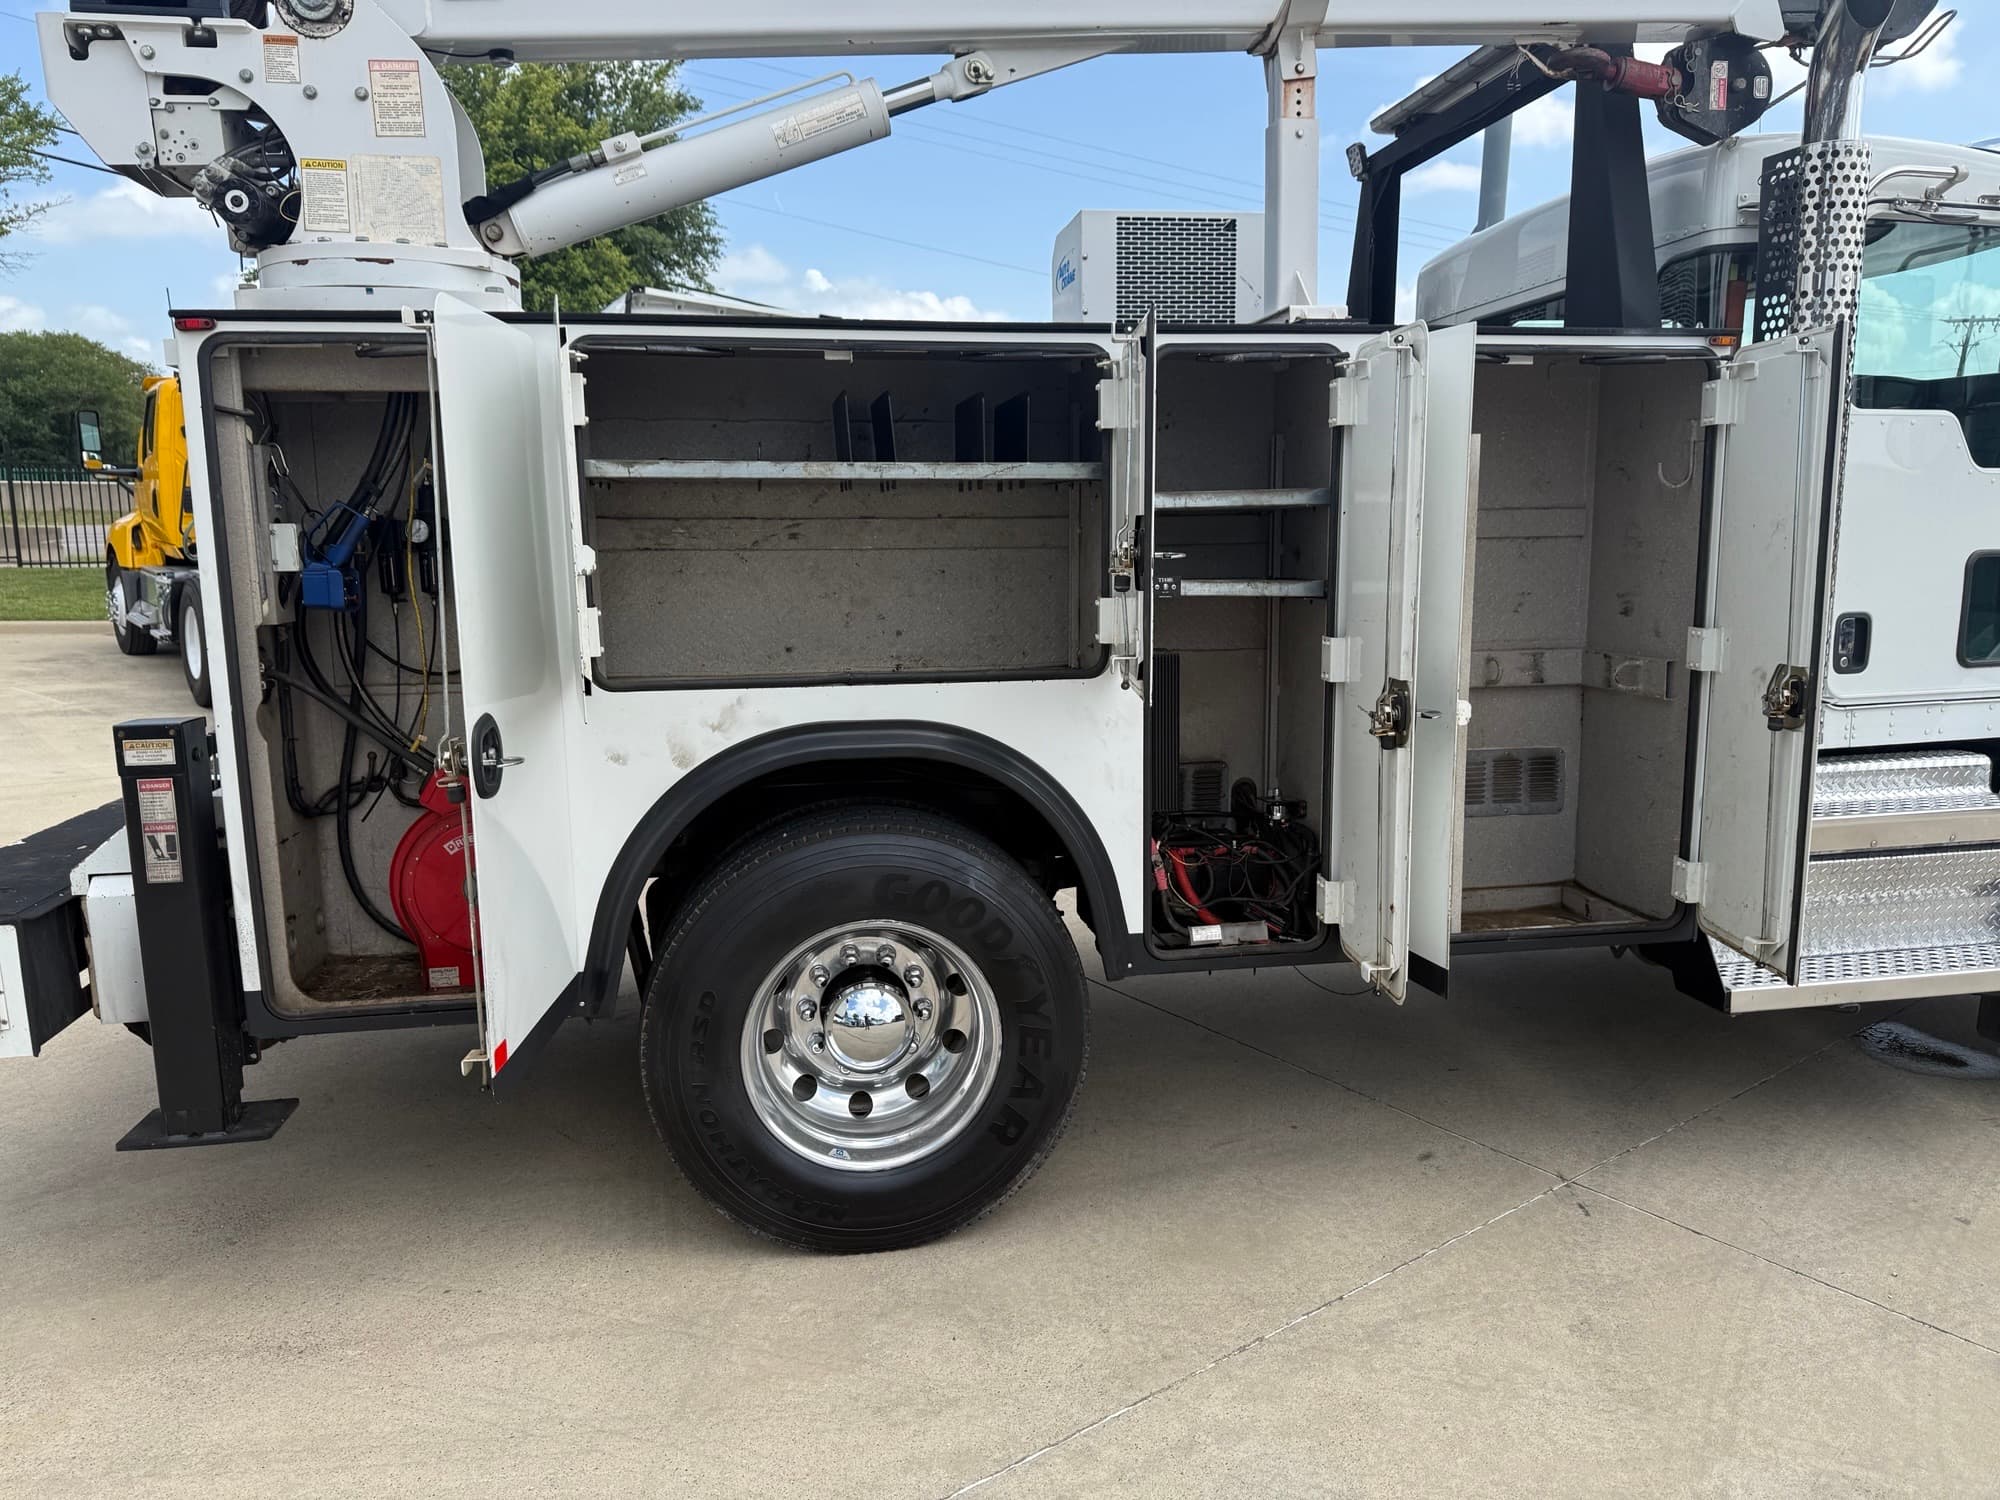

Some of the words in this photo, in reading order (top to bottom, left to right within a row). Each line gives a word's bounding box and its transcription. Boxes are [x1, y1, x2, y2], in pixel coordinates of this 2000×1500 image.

[381, 62, 416, 70] DANGER
[311, 161, 344, 169] CAUTION
[872, 872, 1052, 1147] GOODYEAR
[687, 1081, 853, 1222] MARATHON
